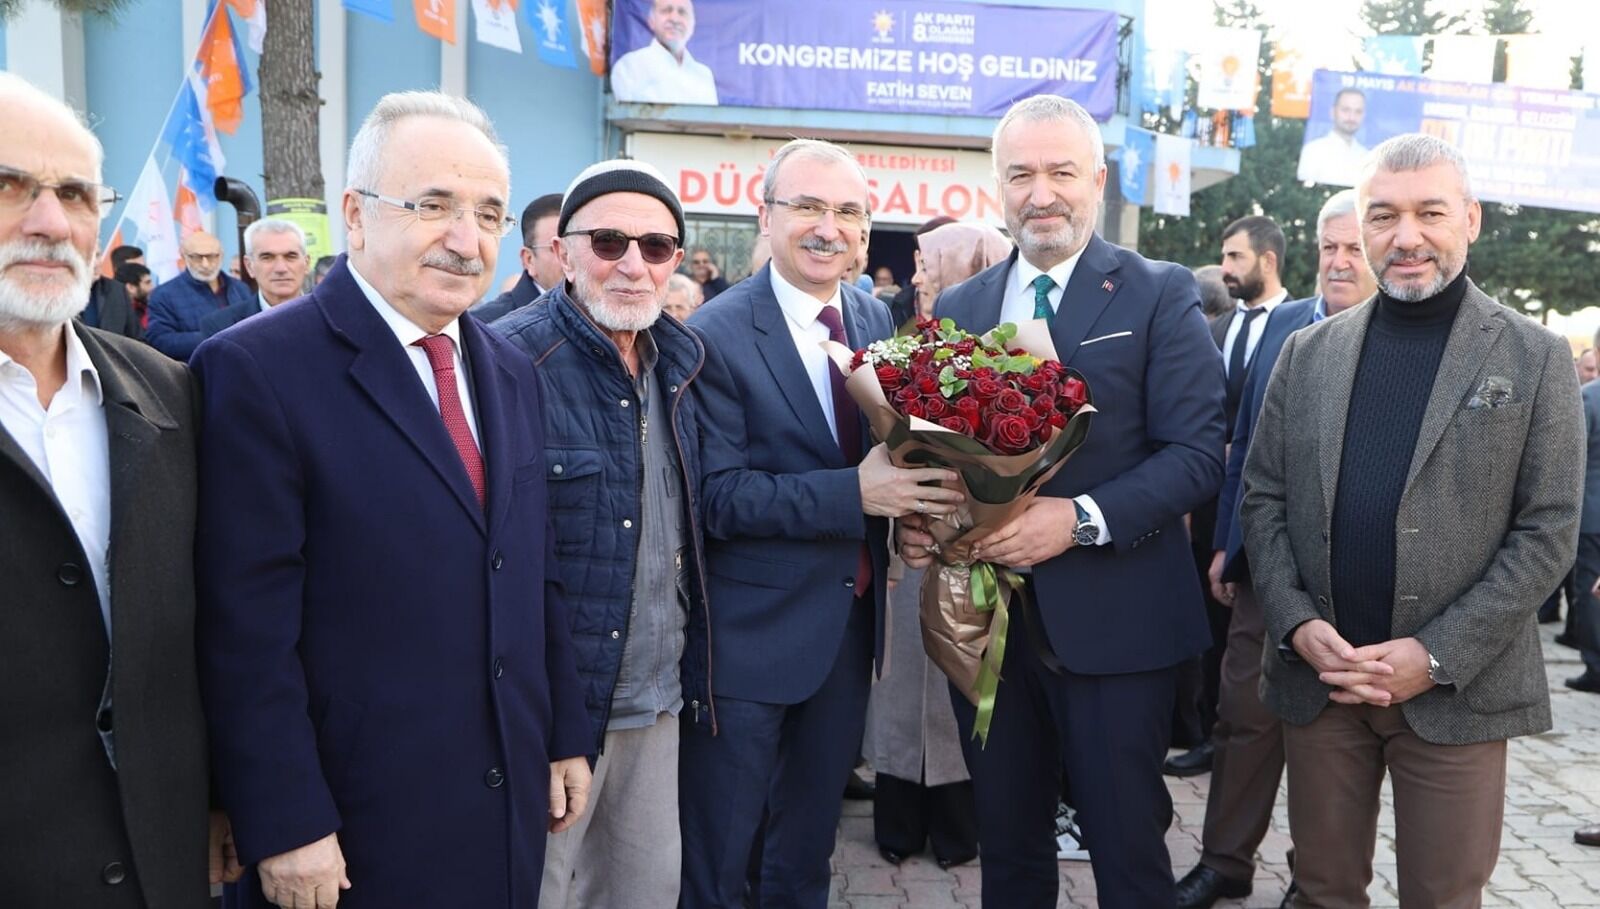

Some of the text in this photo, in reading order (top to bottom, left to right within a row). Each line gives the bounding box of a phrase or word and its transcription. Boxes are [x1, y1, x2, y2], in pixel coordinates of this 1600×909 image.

[914, 12, 934, 24] AK
[918, 51, 975, 81] HOŞ
[867, 79, 972, 101] FATİH SEVEN
[1356, 76, 1395, 91] MAYIS
[857, 153, 956, 172] BELEDİYESİ
[680, 163, 1004, 219] DÜĞ SALON
